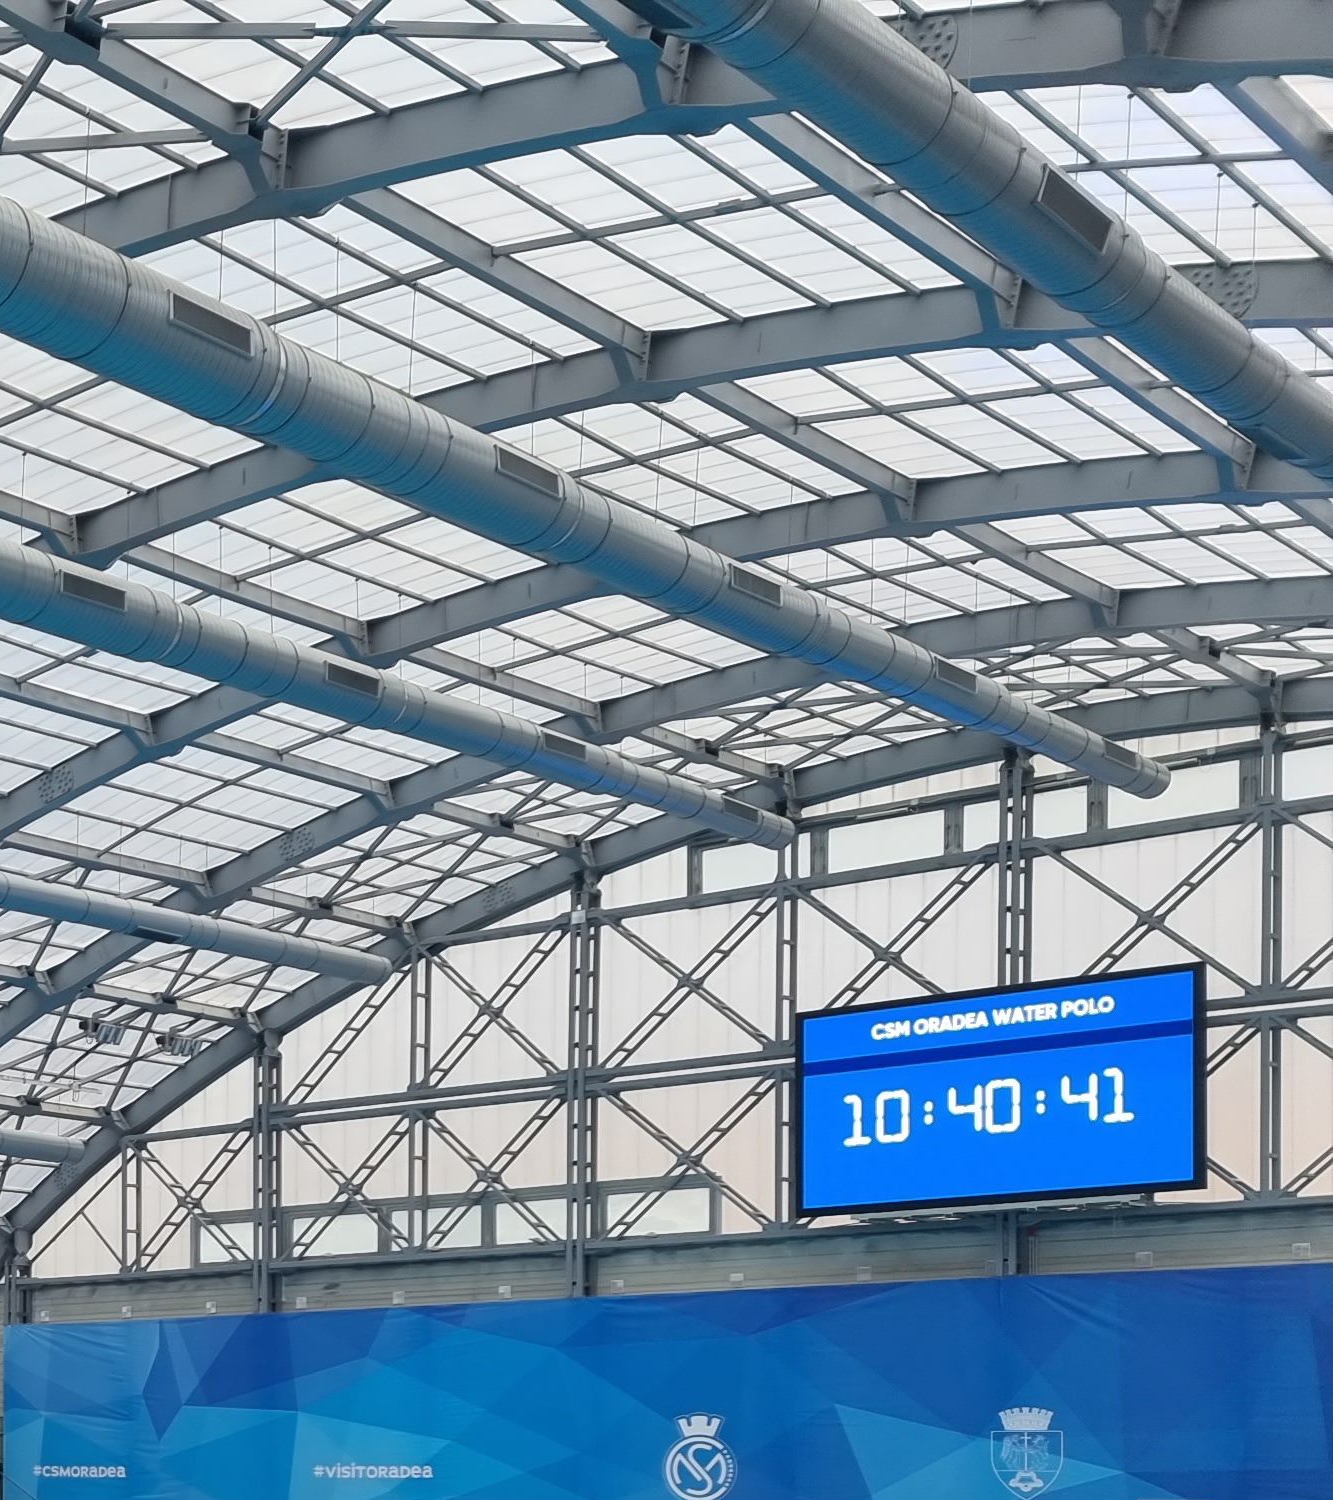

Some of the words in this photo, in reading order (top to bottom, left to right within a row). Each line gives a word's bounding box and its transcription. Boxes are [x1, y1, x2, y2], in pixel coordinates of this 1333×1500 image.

[871, 1020, 910, 1041] CSM
[913, 1011, 988, 1035] ORADEA
[992, 1003, 1057, 1026] WATER
[1061, 995, 1115, 1018] POLO
